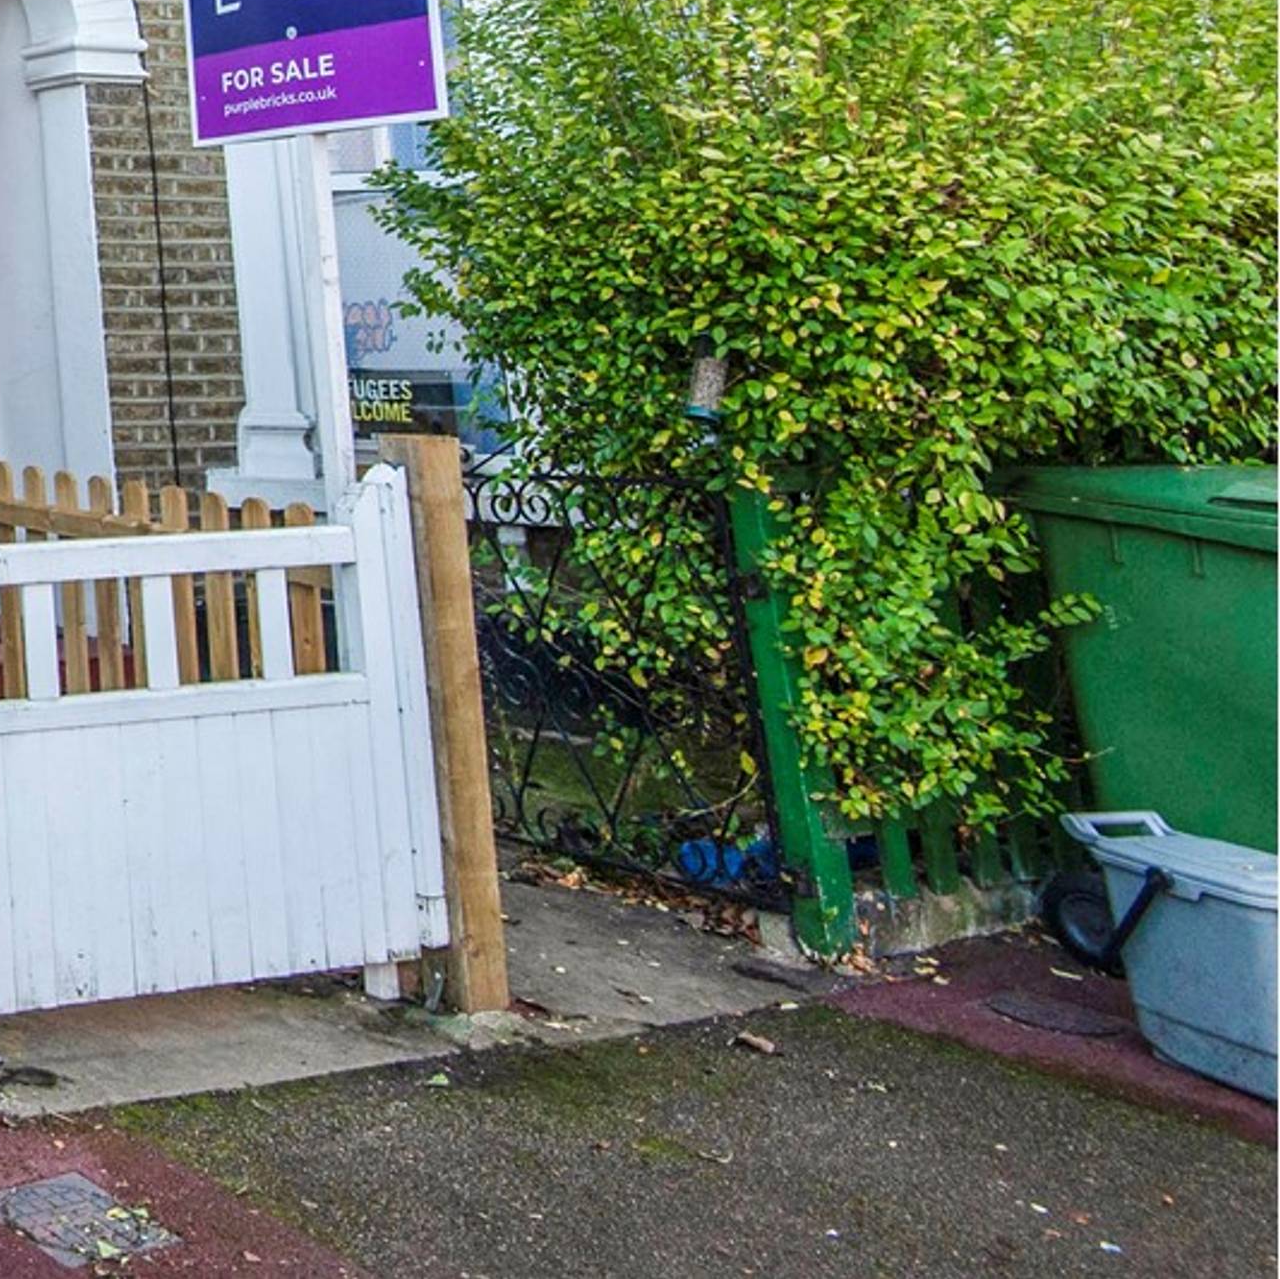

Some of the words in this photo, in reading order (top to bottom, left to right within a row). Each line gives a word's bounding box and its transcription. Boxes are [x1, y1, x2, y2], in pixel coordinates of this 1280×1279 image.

[221, 66, 265, 94] FOR
[270, 53, 336, 83] SALE
[223, 85, 337, 118] purplebricks.co.uk
